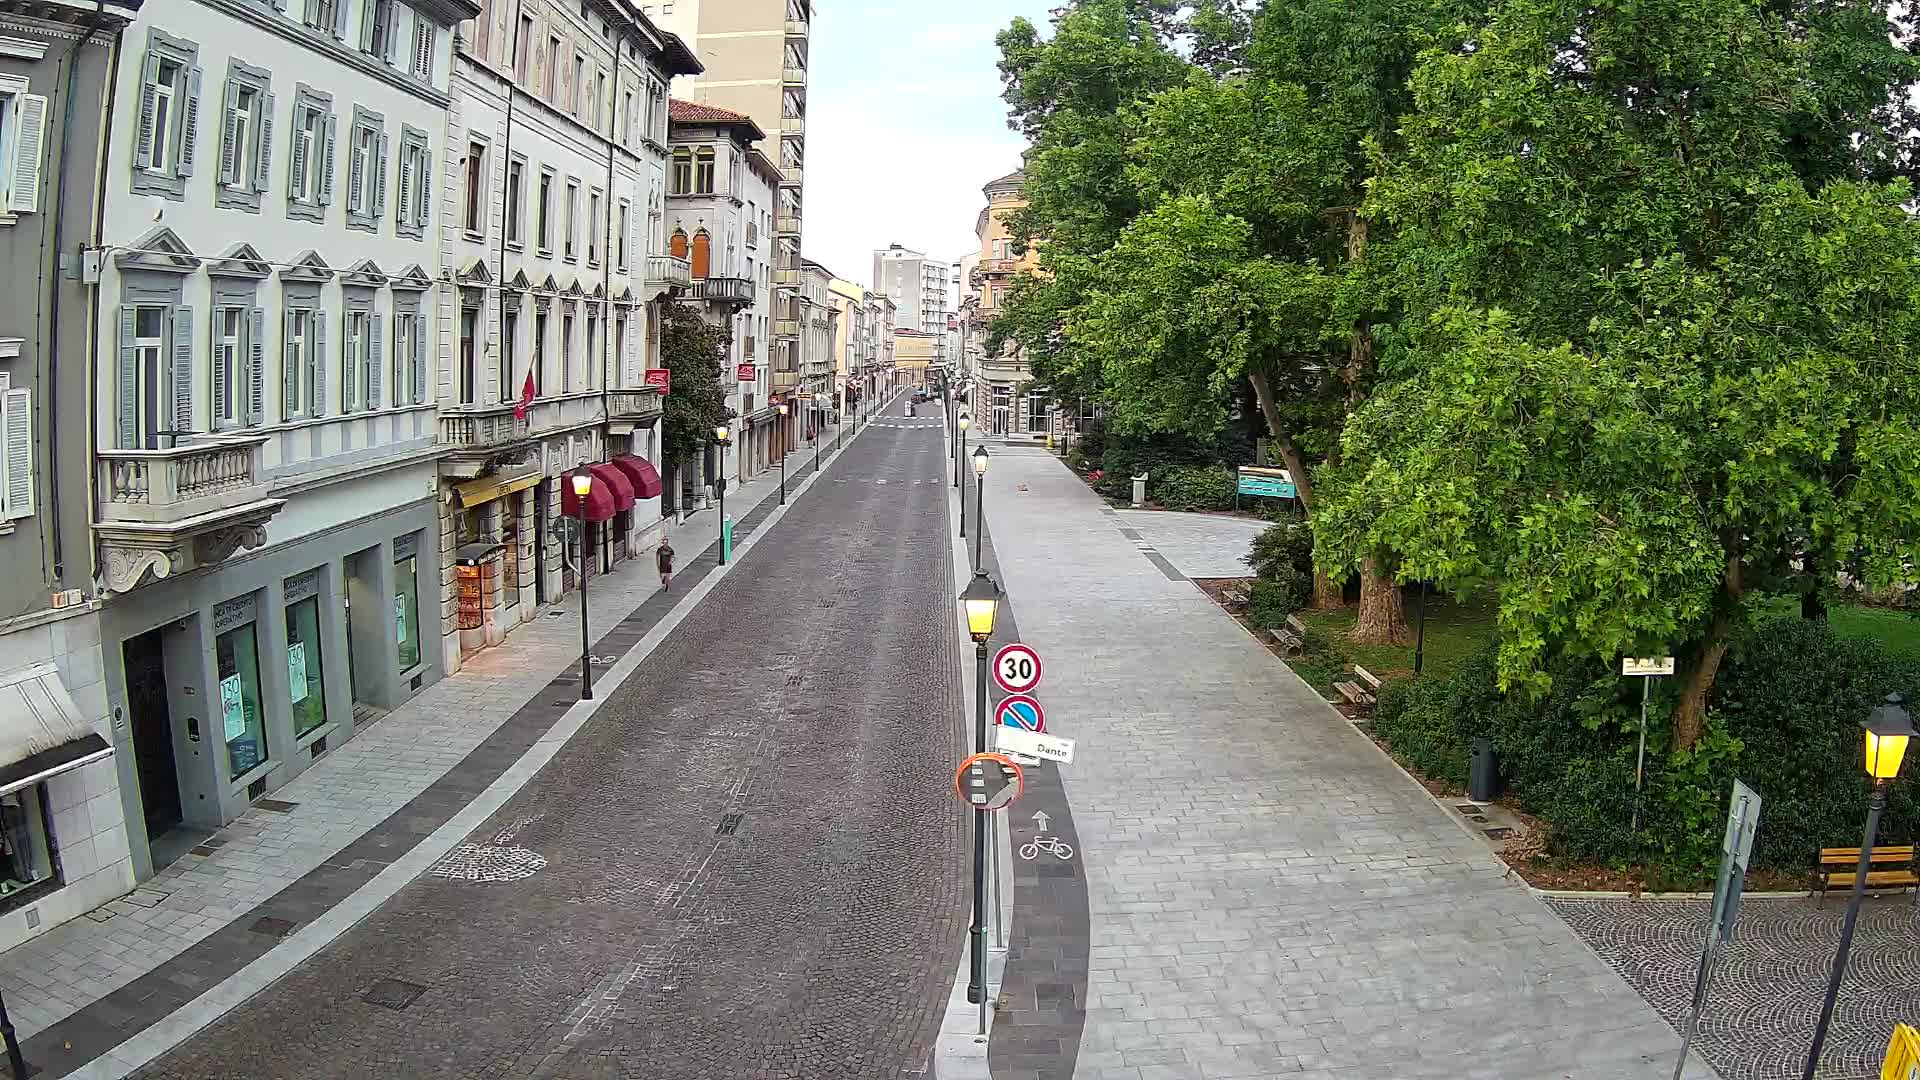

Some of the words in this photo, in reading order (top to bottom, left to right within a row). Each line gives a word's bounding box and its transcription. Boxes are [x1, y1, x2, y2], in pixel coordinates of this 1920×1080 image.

[1004, 657, 1032, 680] 30
[222, 677, 240, 701] 130
[1037, 743, 1067, 757] Dante
